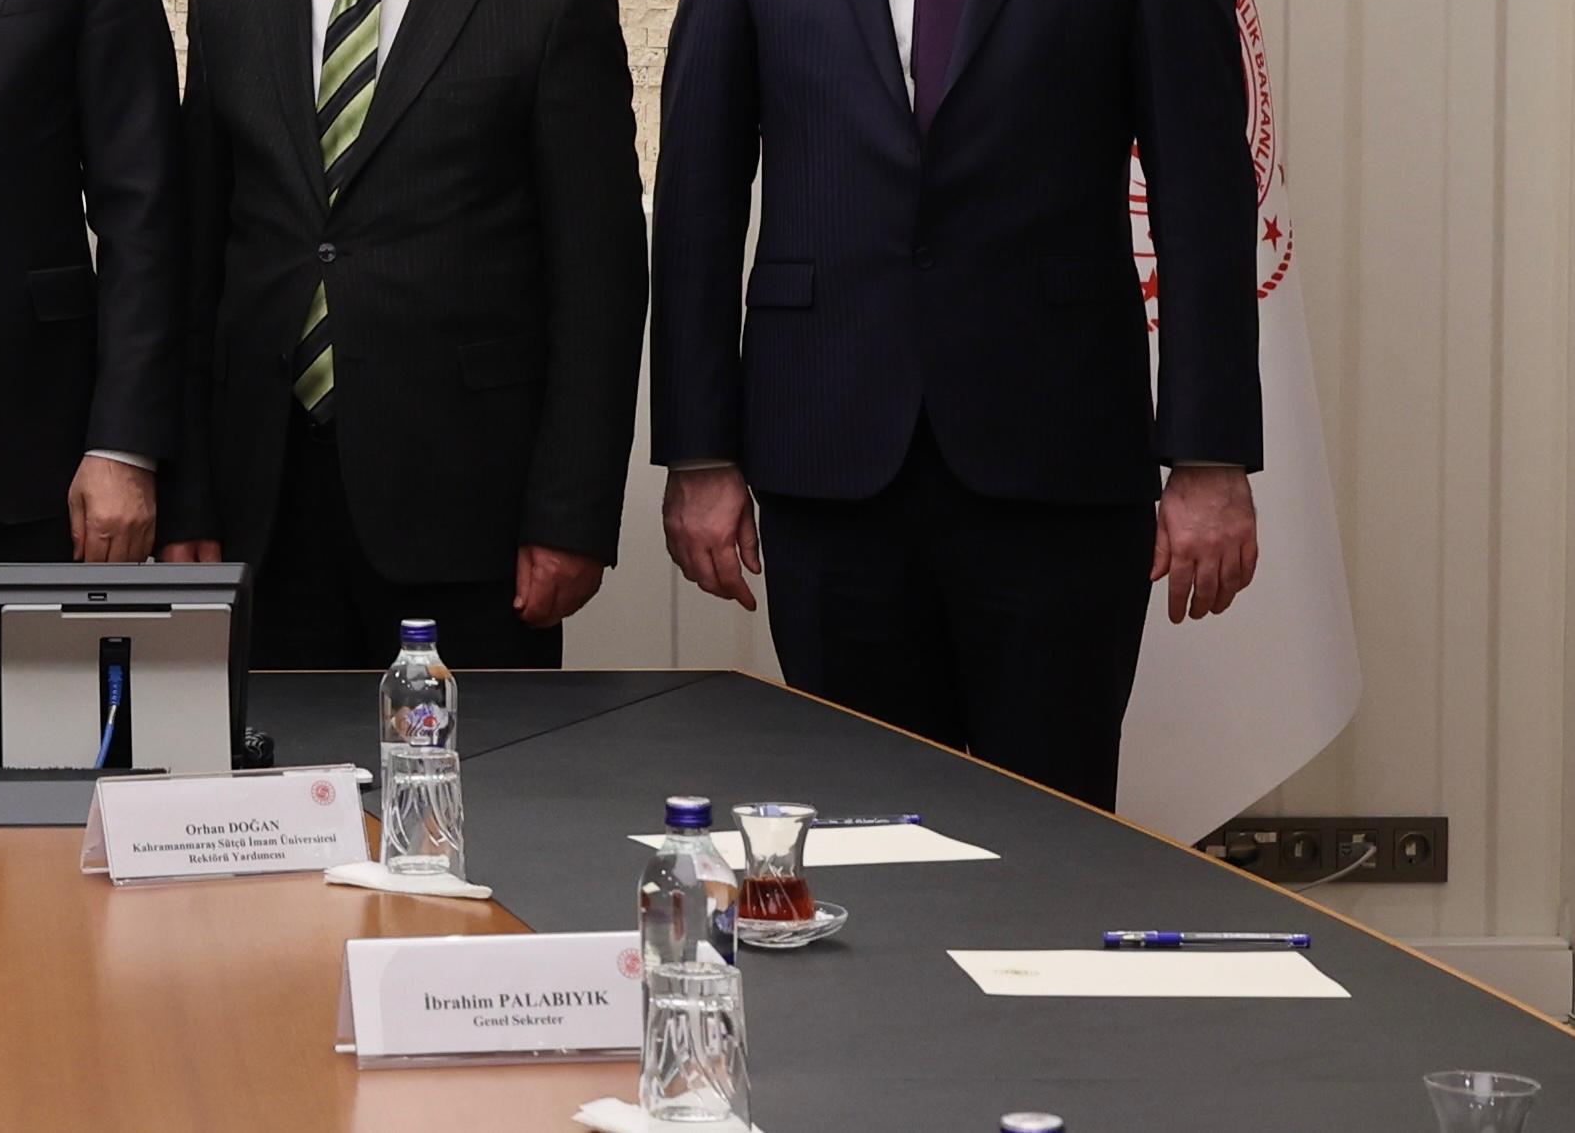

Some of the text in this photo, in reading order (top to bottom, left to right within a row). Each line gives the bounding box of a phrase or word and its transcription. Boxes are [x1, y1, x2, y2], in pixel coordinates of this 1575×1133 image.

[186, 819, 280, 836] Orhan DOĞAN
[132, 833, 337, 854] Kahramanmaraş Sütçü İmam Üniversitesi
[189, 850, 286, 864] Rektörü Yardımcısı
[424, 989, 610, 1011] İbrahim PALABIYIK
[473, 1013, 564, 1028] Genel Sekreter
